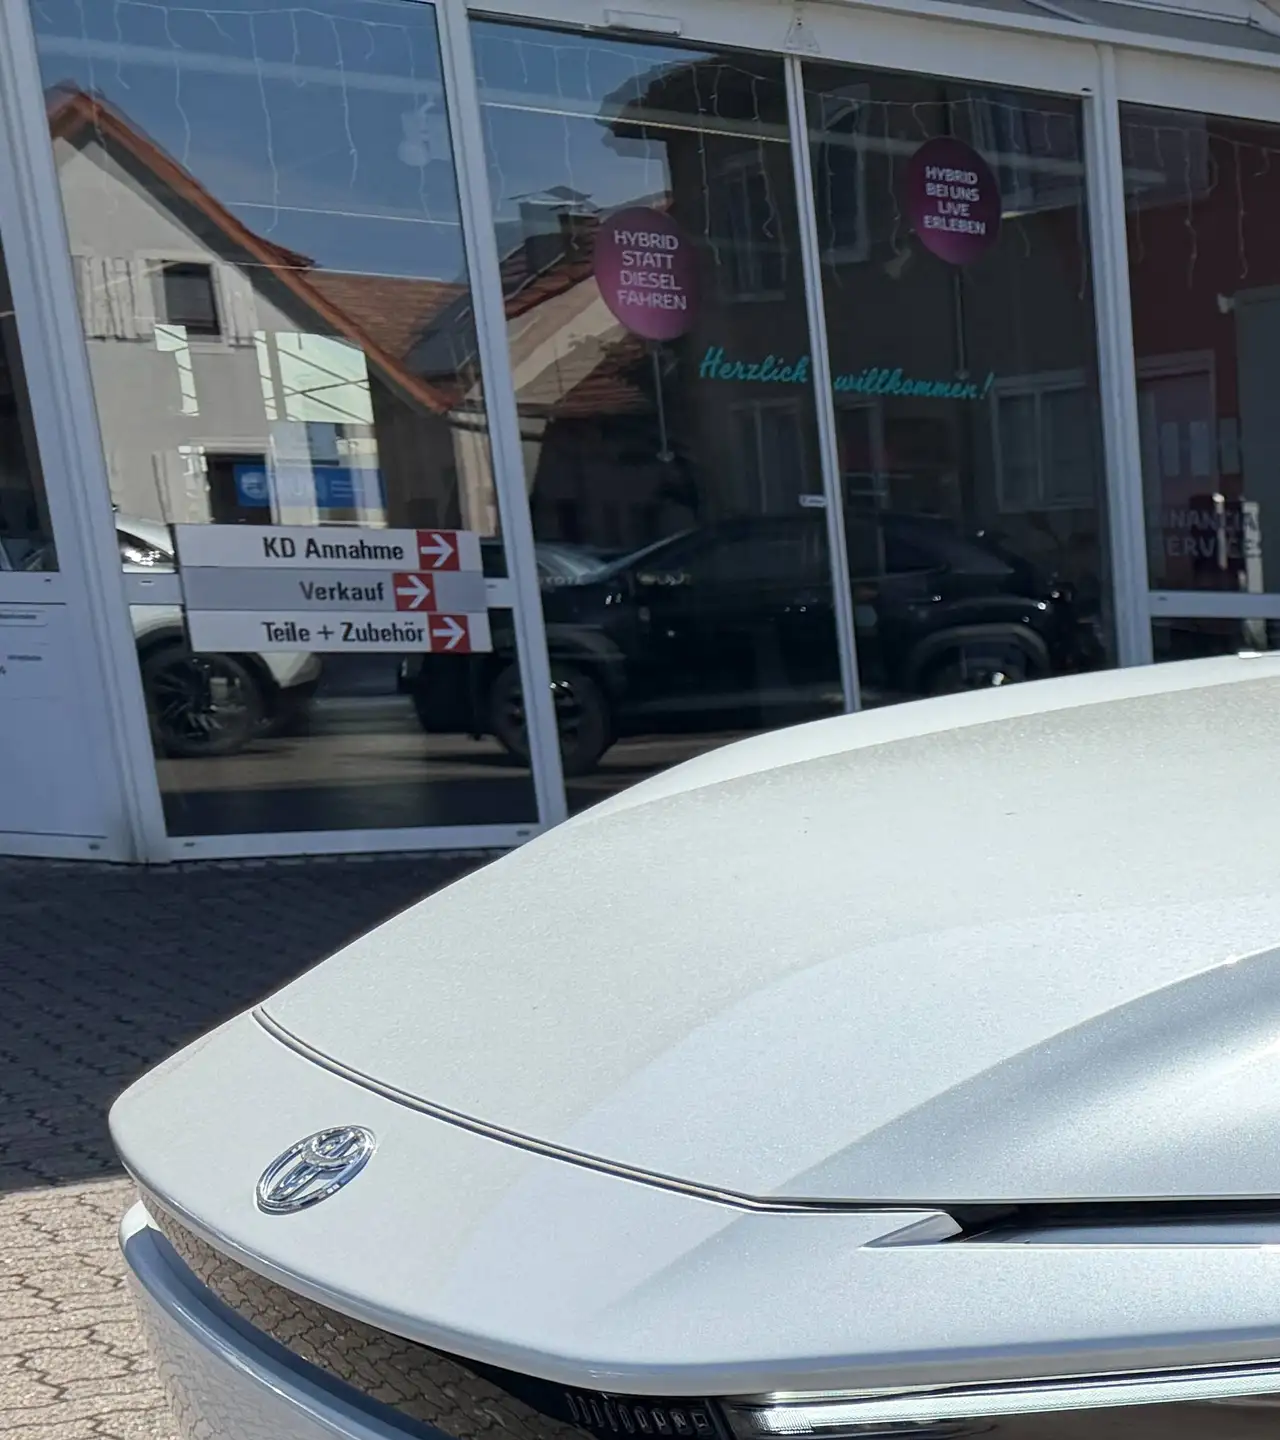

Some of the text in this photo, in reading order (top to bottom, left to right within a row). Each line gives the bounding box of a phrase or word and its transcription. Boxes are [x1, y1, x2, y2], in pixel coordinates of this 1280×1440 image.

[925, 165, 979, 185] HYBRID
[925, 182, 980, 202] BEI UNS
[937, 200, 971, 217] LIVE
[923, 215, 986, 235] ERLEBEN
[614, 229, 679, 250] HYBRID
[622, 250, 674, 270] STATT
[620, 269, 683, 291] DIESEL
[617, 289, 687, 311] FAHREN
[700, 346, 995, 400] Herzlich willkommen!
[263, 537, 404, 560] KD Annahme
[299, 580, 385, 602] Verkauf
[261, 620, 425, 644] Teile + Zubehör
